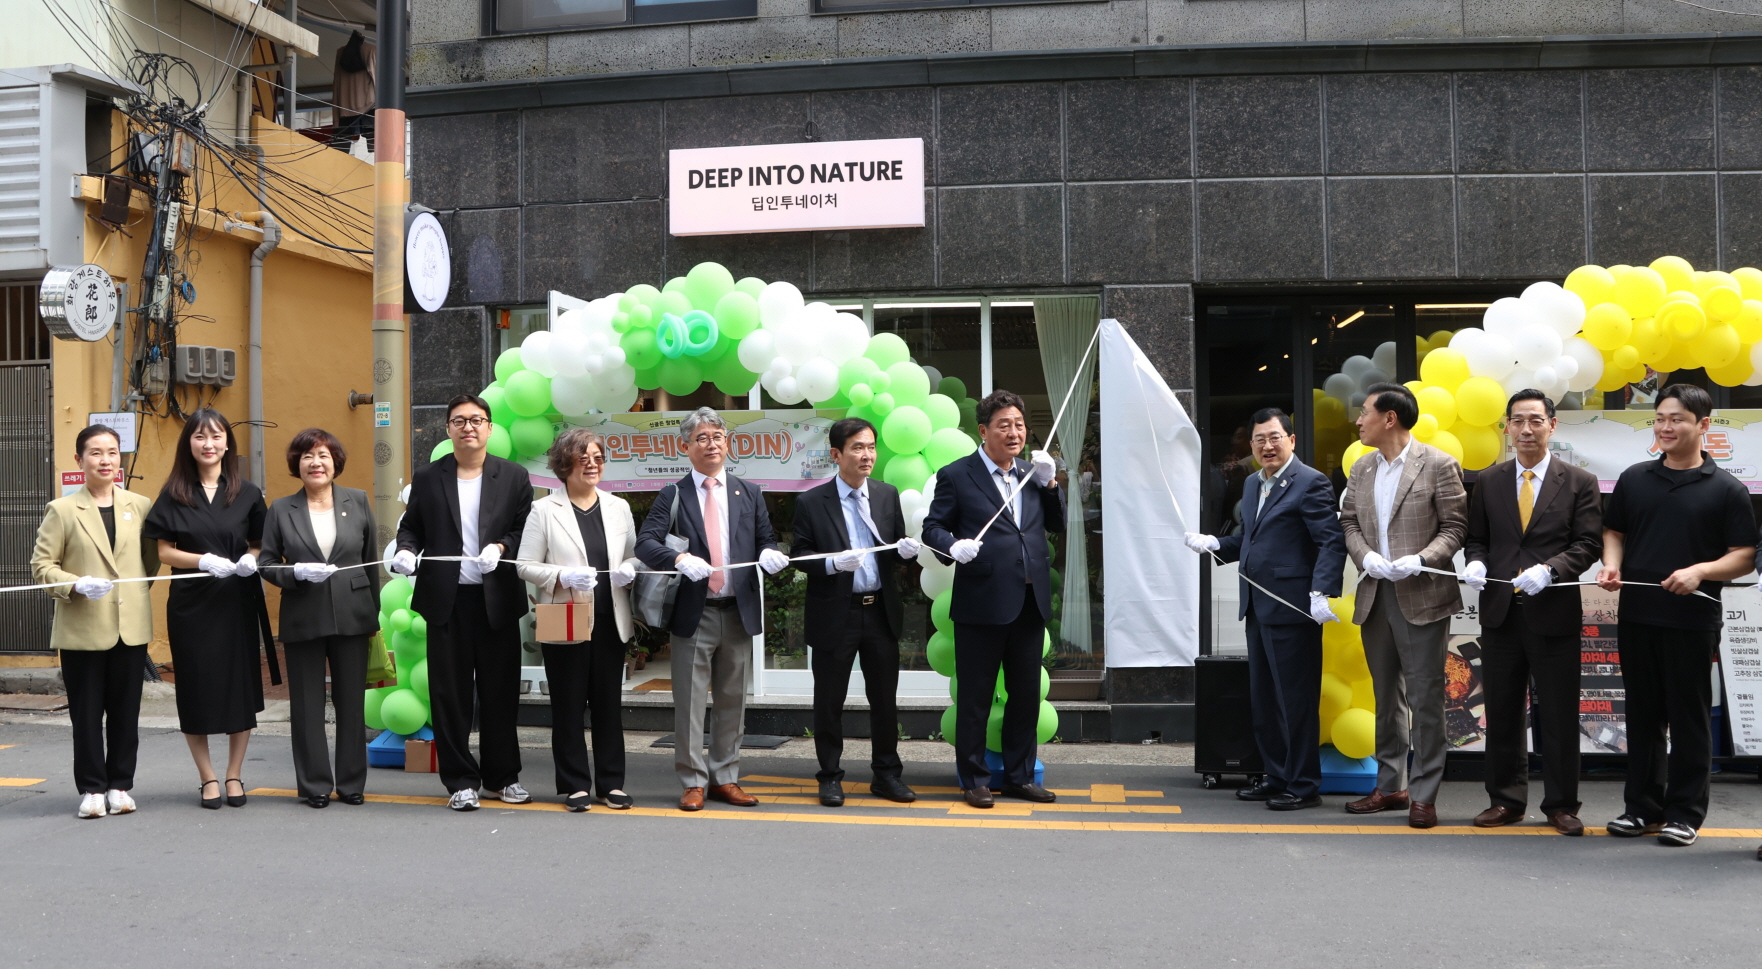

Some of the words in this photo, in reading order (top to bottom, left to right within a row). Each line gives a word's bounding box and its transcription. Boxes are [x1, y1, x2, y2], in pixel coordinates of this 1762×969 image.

[688, 167, 743, 189] DEEP
[748, 164, 805, 187] INTO
[810, 160, 903, 184] NATURE
[751, 193, 838, 211] 딥인투네이처
[64, 474, 83, 482] 쓰레기
[1726, 610, 1747, 621] 고기
